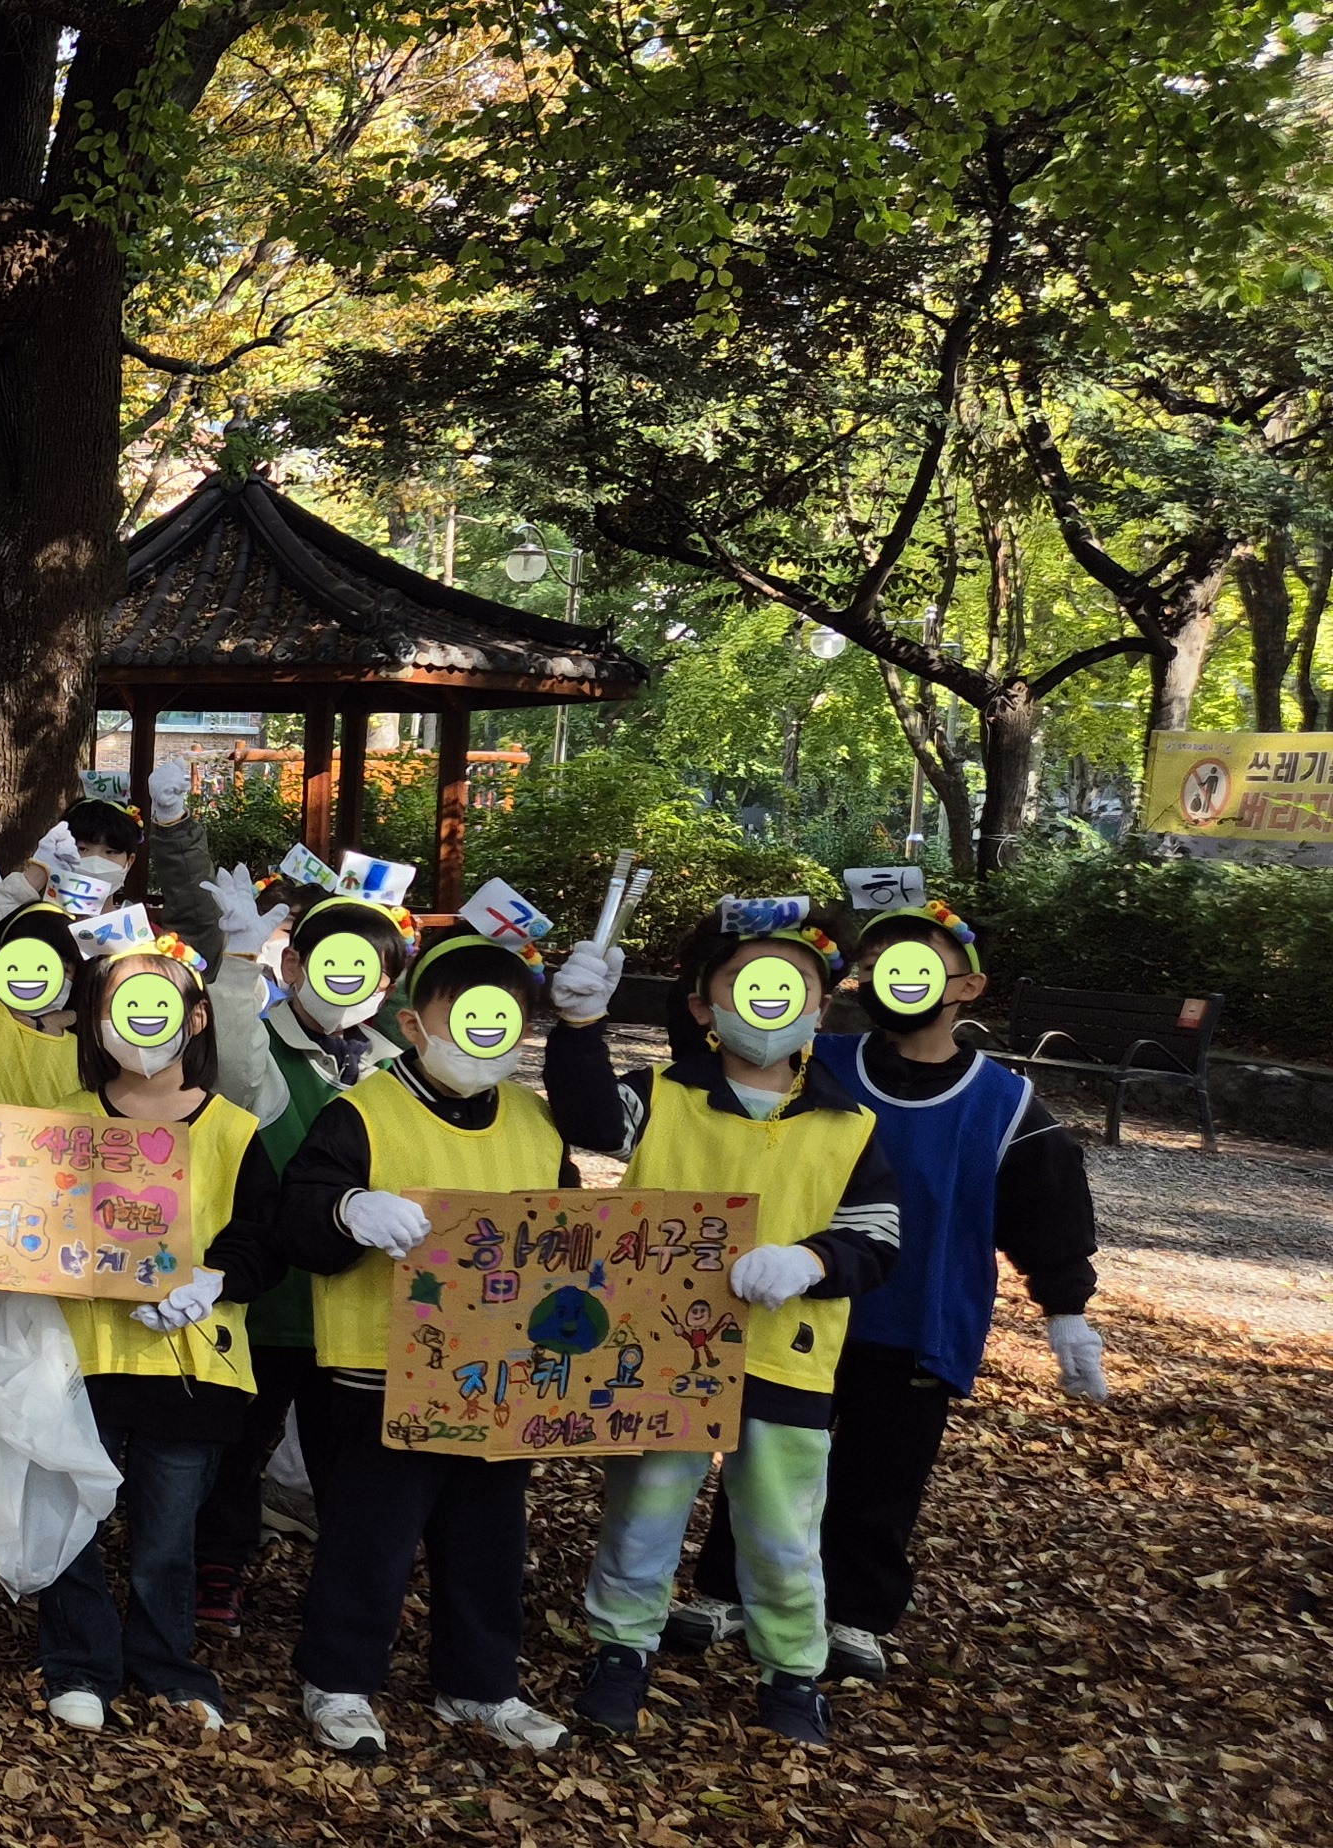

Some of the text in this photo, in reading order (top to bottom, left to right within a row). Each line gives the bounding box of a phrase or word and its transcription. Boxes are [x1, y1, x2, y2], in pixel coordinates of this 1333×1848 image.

[861, 871, 915, 904] 하
[32, 1126, 139, 1172] 사용을
[610, 1217, 729, 1274] 지구를
[453, 1344, 644, 1405] 지켜요
[430, 1420, 489, 1442] 2025
[606, 1409, 675, 1441] 1학년
